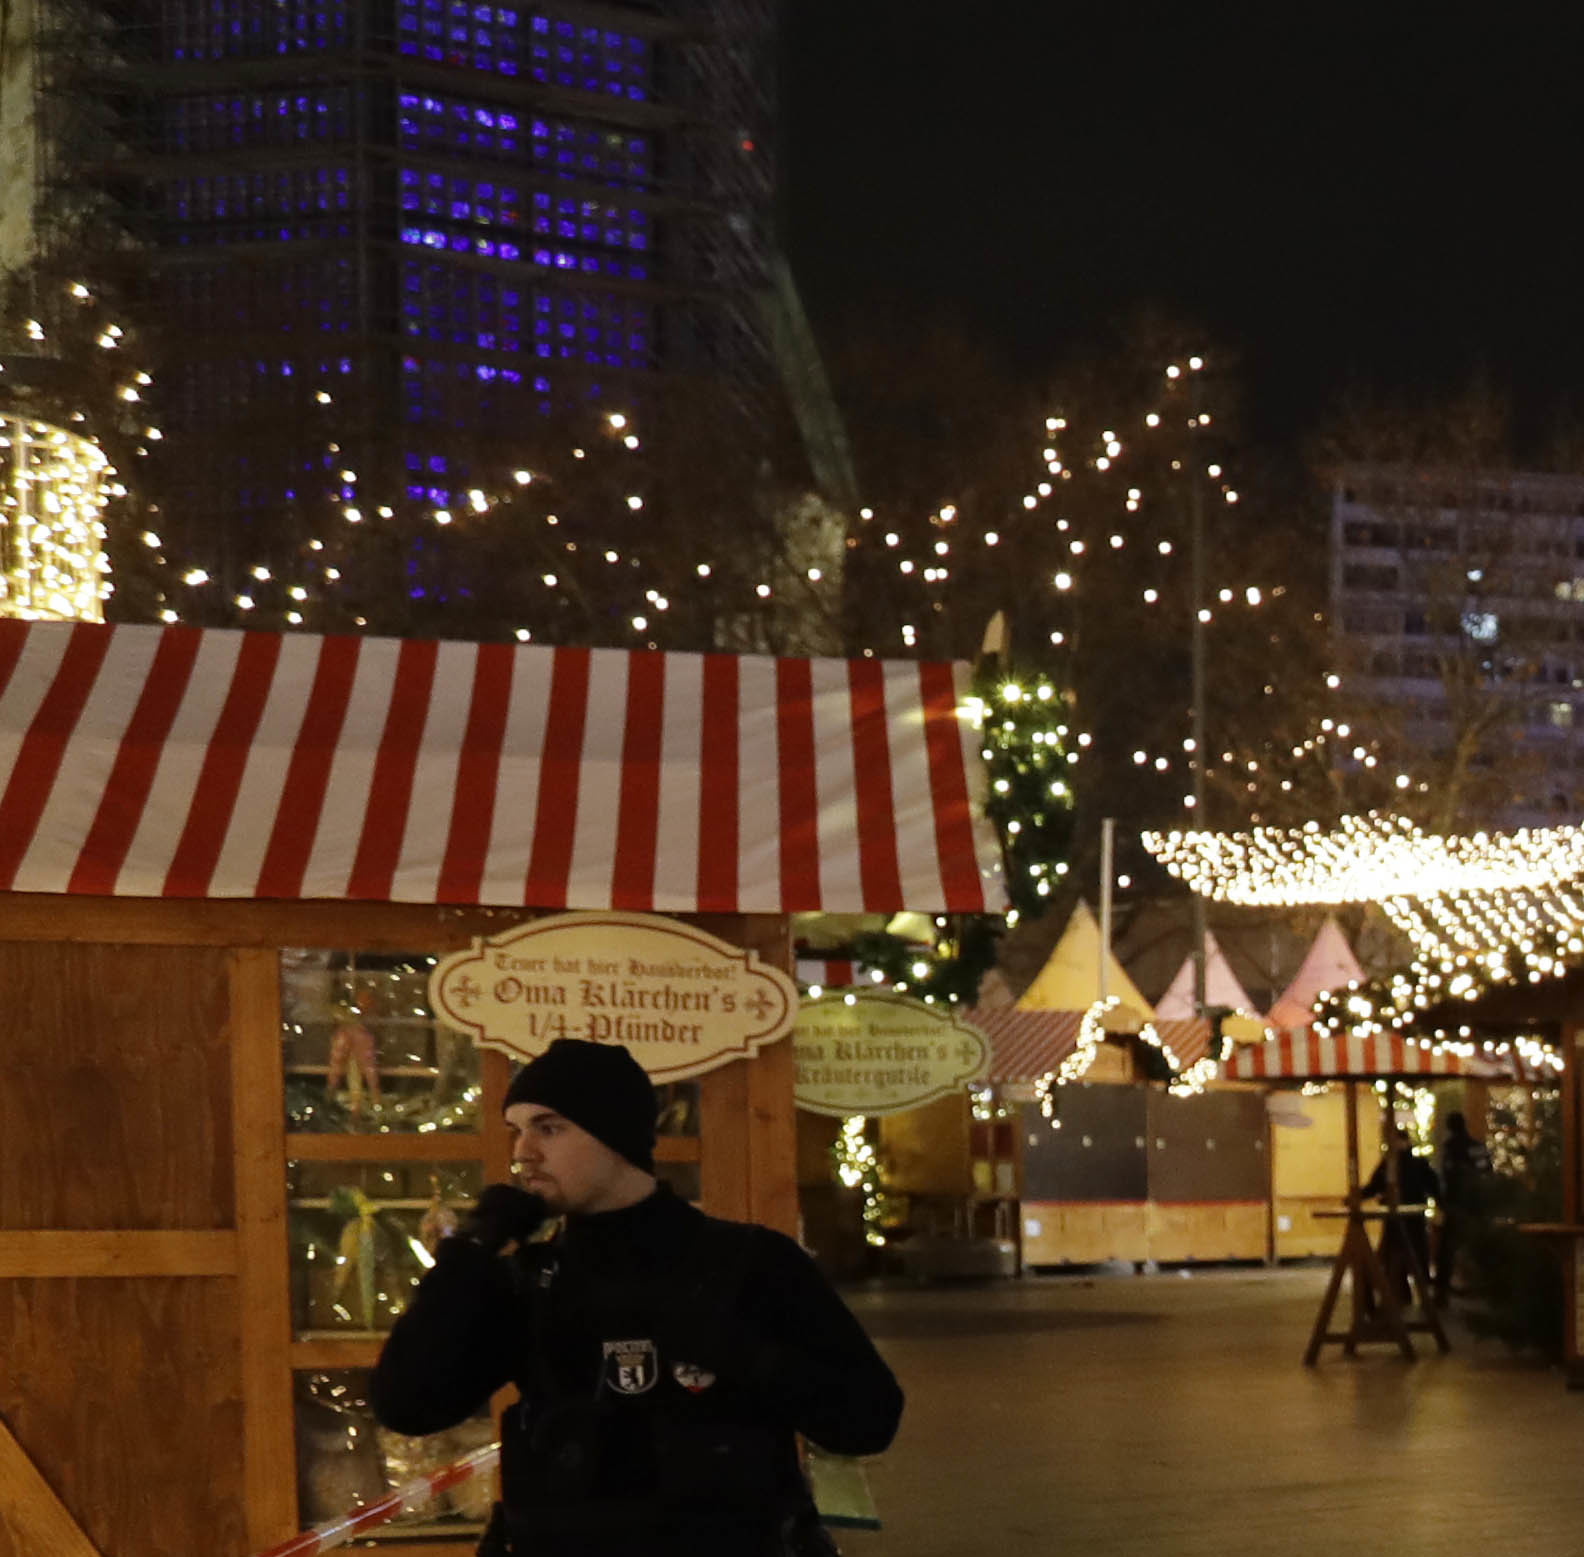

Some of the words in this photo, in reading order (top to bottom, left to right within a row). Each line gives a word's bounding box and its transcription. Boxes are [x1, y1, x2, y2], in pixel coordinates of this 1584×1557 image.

[494, 977, 567, 1006] Oma
[579, 980, 736, 1014] Klärchen's
[793, 1043, 824, 1061] ma
